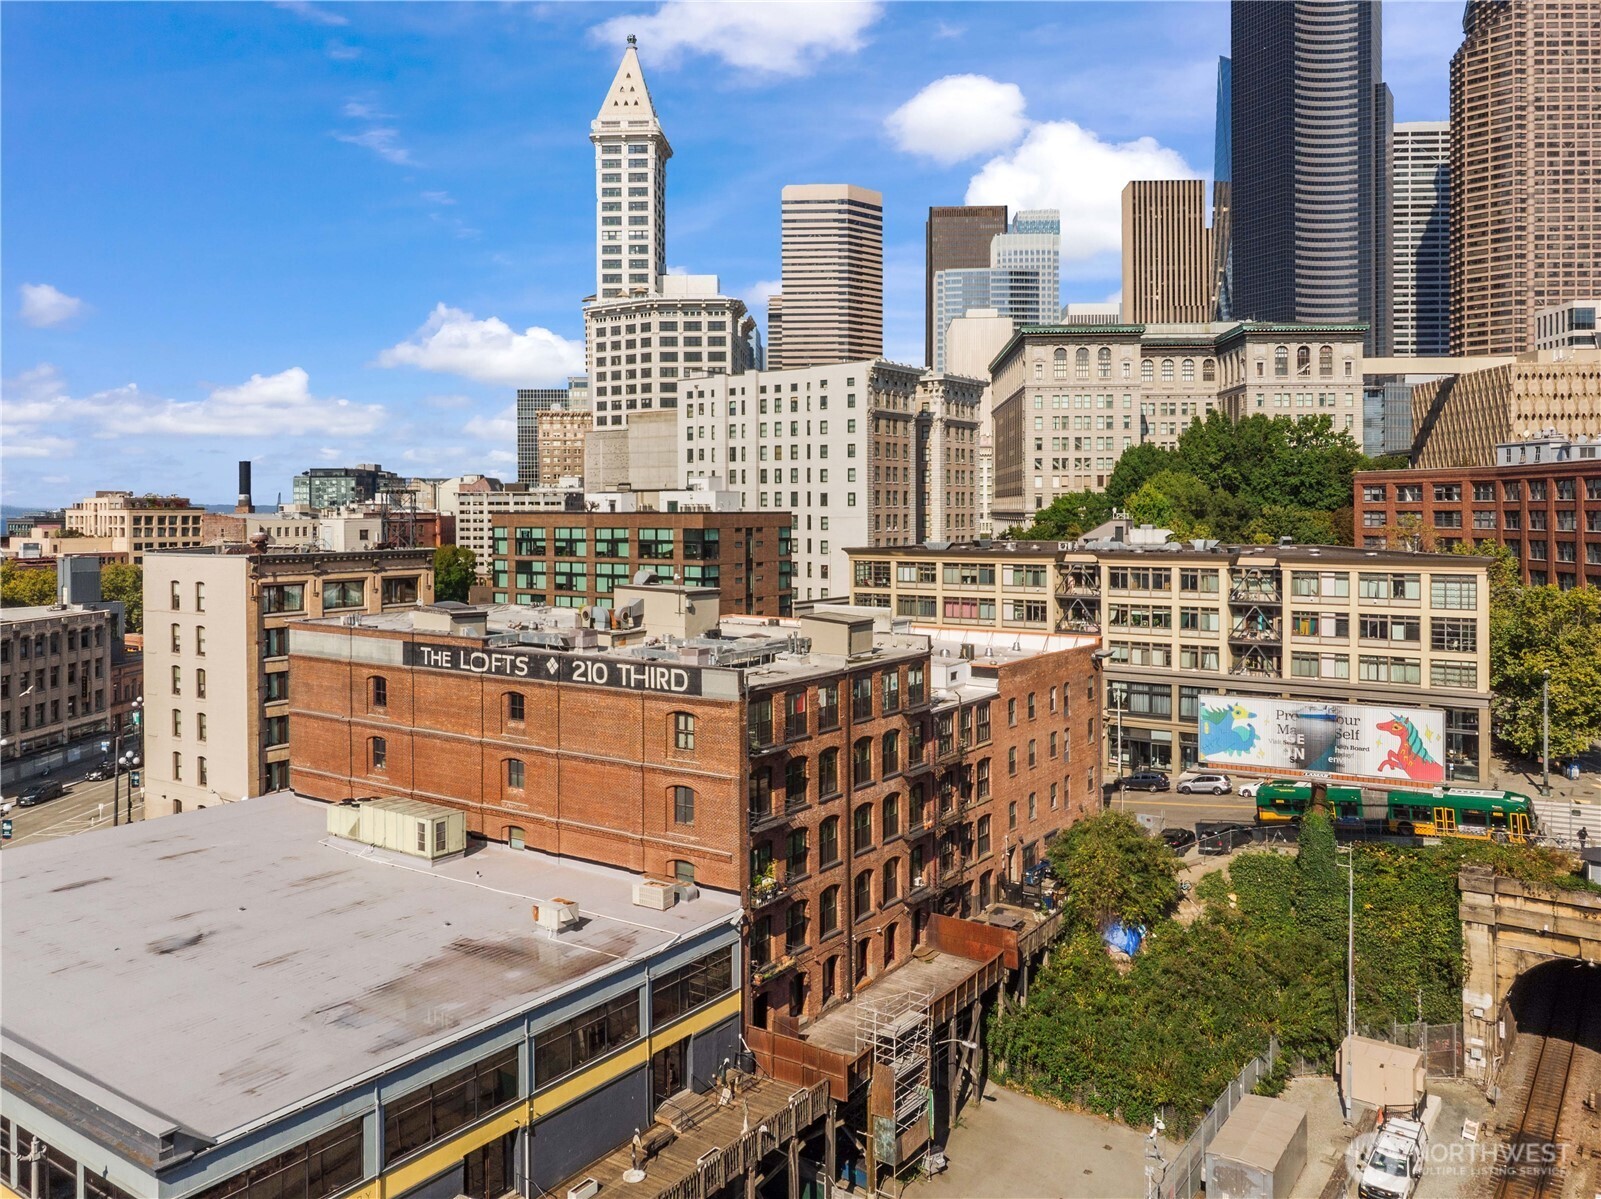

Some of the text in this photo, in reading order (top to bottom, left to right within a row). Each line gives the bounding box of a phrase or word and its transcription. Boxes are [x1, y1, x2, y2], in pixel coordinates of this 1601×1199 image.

[420, 647, 689, 692] THE LOFTS 210 THIRD
[1335, 716, 1360, 726] our
